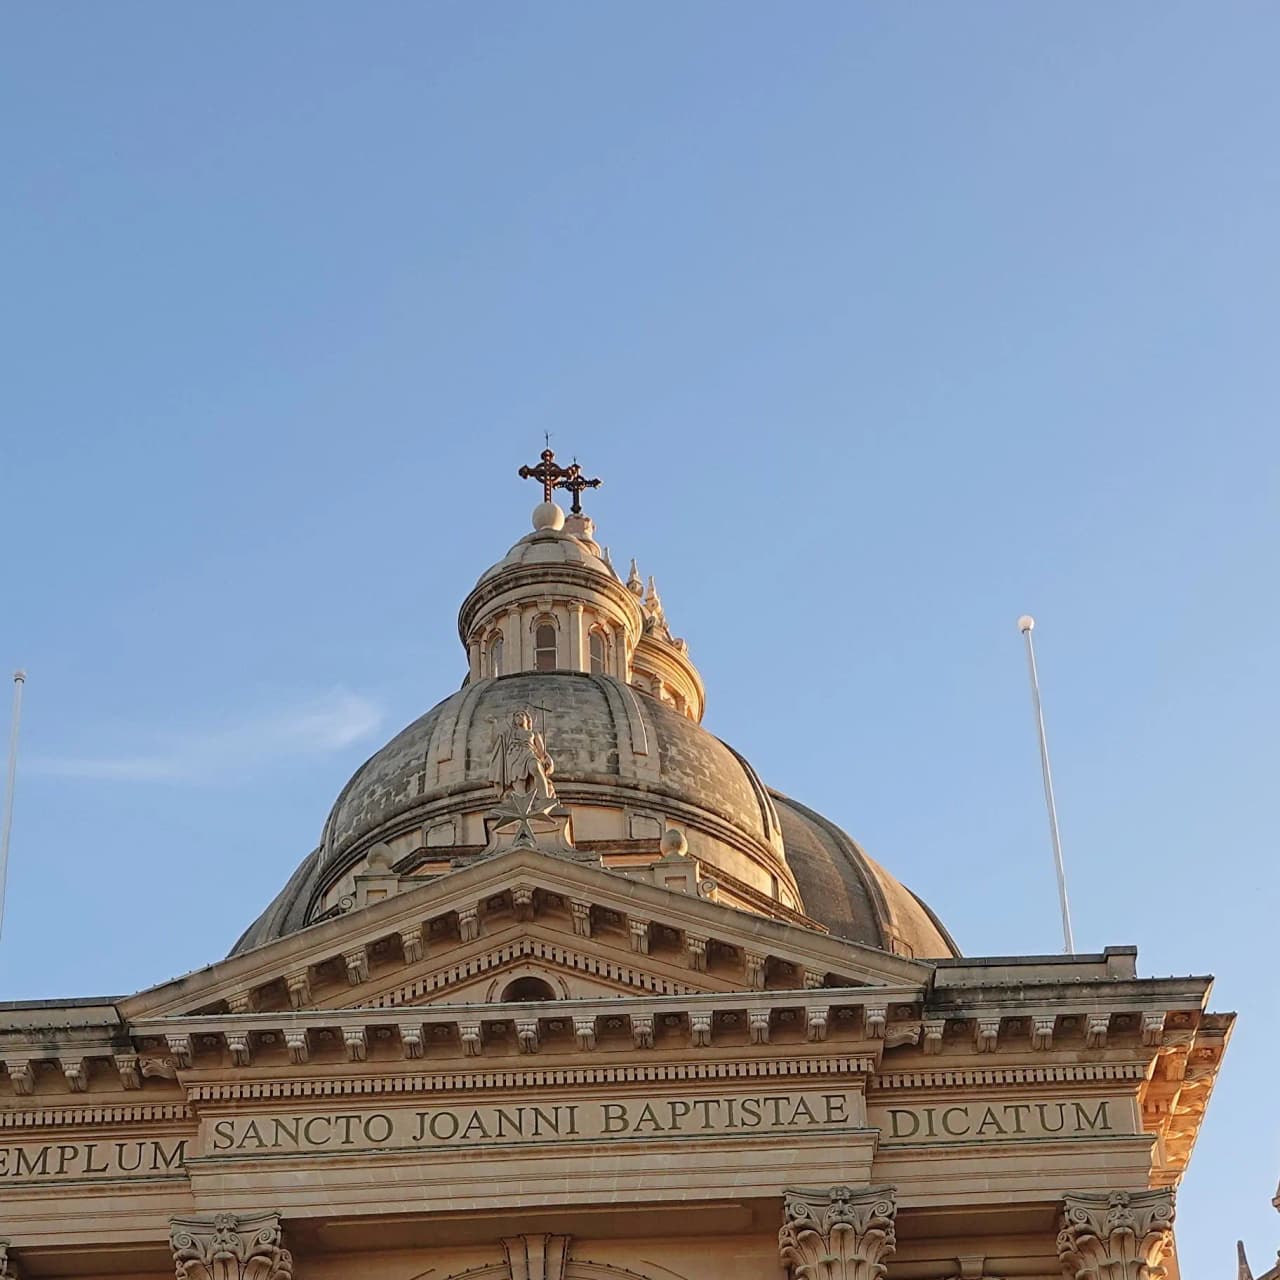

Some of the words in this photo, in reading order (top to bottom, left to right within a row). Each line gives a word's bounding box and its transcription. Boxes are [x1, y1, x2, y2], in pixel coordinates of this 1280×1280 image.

[213, 1114, 394, 1150] SANCTO
[412, 1105, 579, 1141] JOANNI
[600, 1094, 850, 1133] BAPTISTAE
[886, 1101, 1113, 1138] DICATUM
